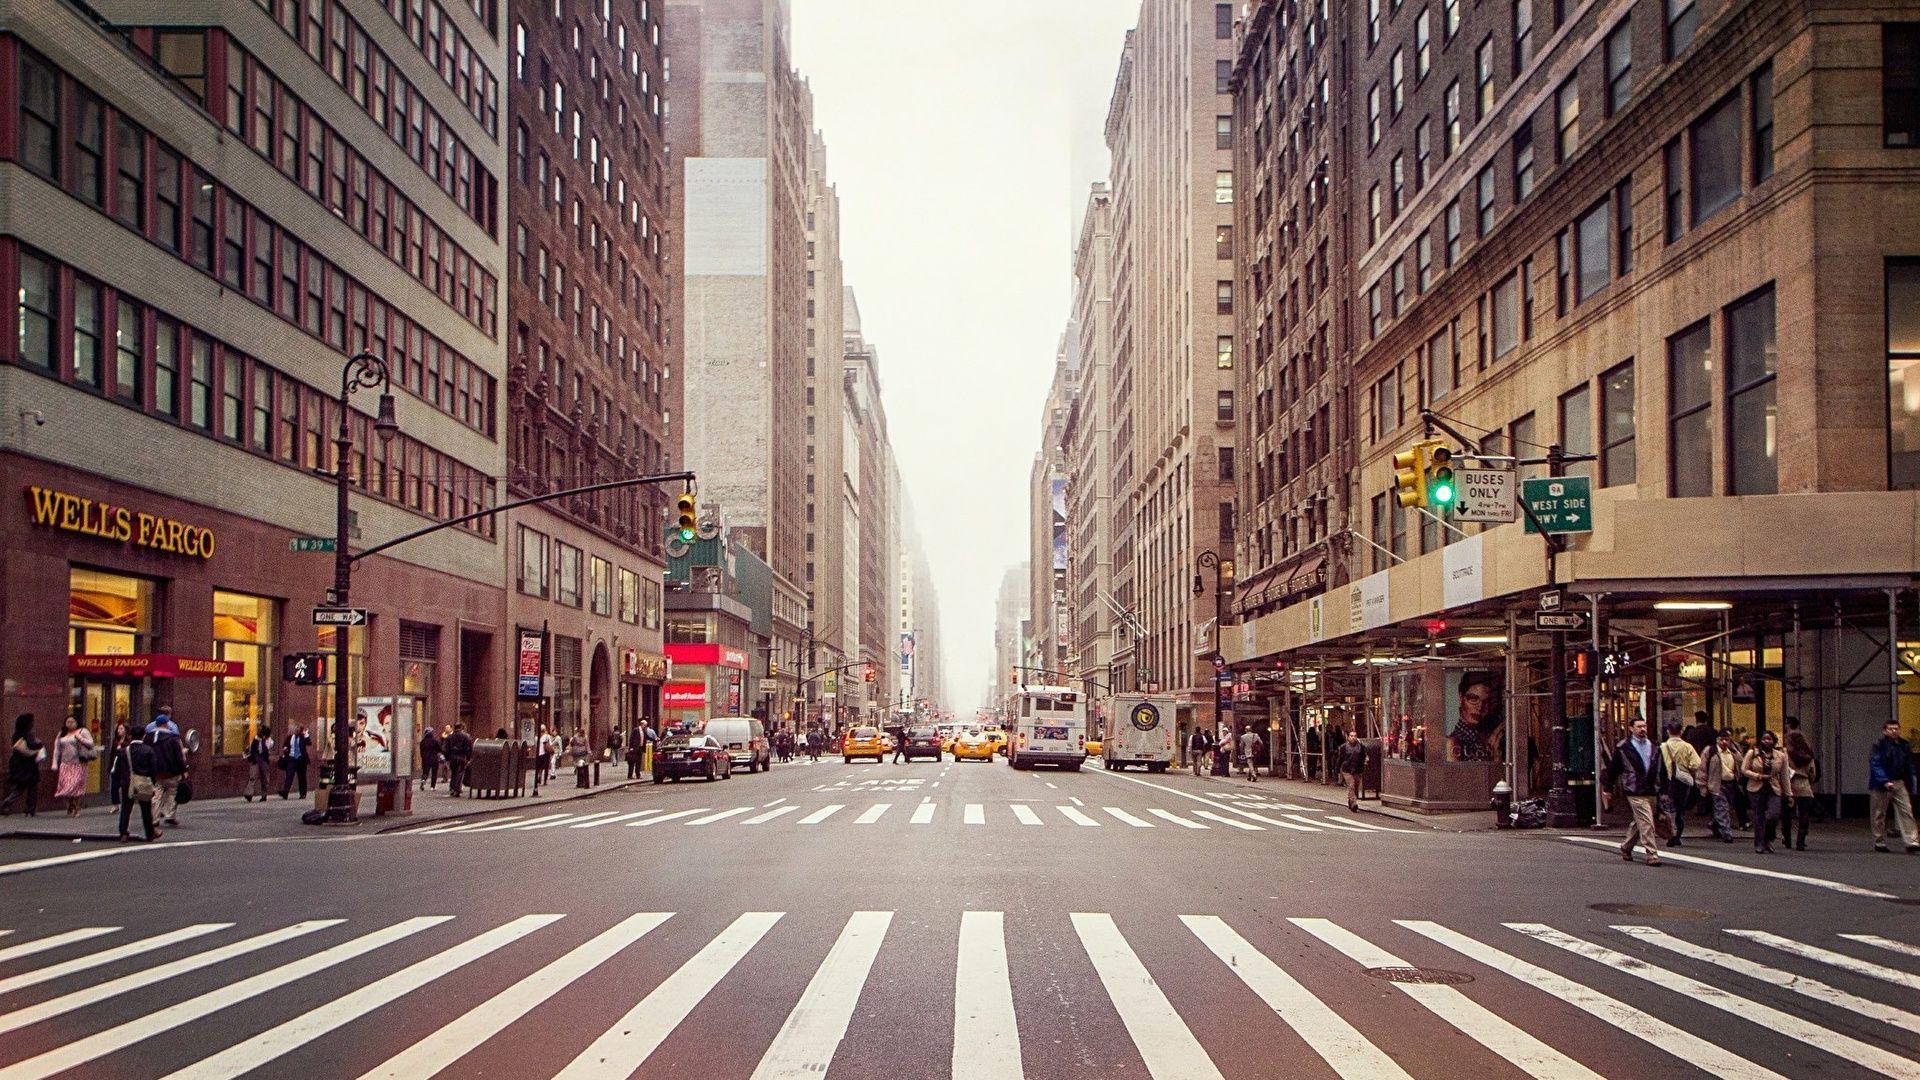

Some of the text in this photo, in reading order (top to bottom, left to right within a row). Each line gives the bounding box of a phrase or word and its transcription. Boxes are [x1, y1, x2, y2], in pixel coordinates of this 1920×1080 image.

[1466, 474, 1504, 485] BUSES
[1469, 487, 1500, 498] ONLY
[1532, 498, 1586, 511] WEST SIDE
[31, 486, 216, 559] WELLS FARGO
[320, 611, 334, 621] ONE
[1543, 617, 1558, 625] ONE
[77, 658, 149, 668] WELLS FARGO
[178, 659, 204, 671] WELLS
